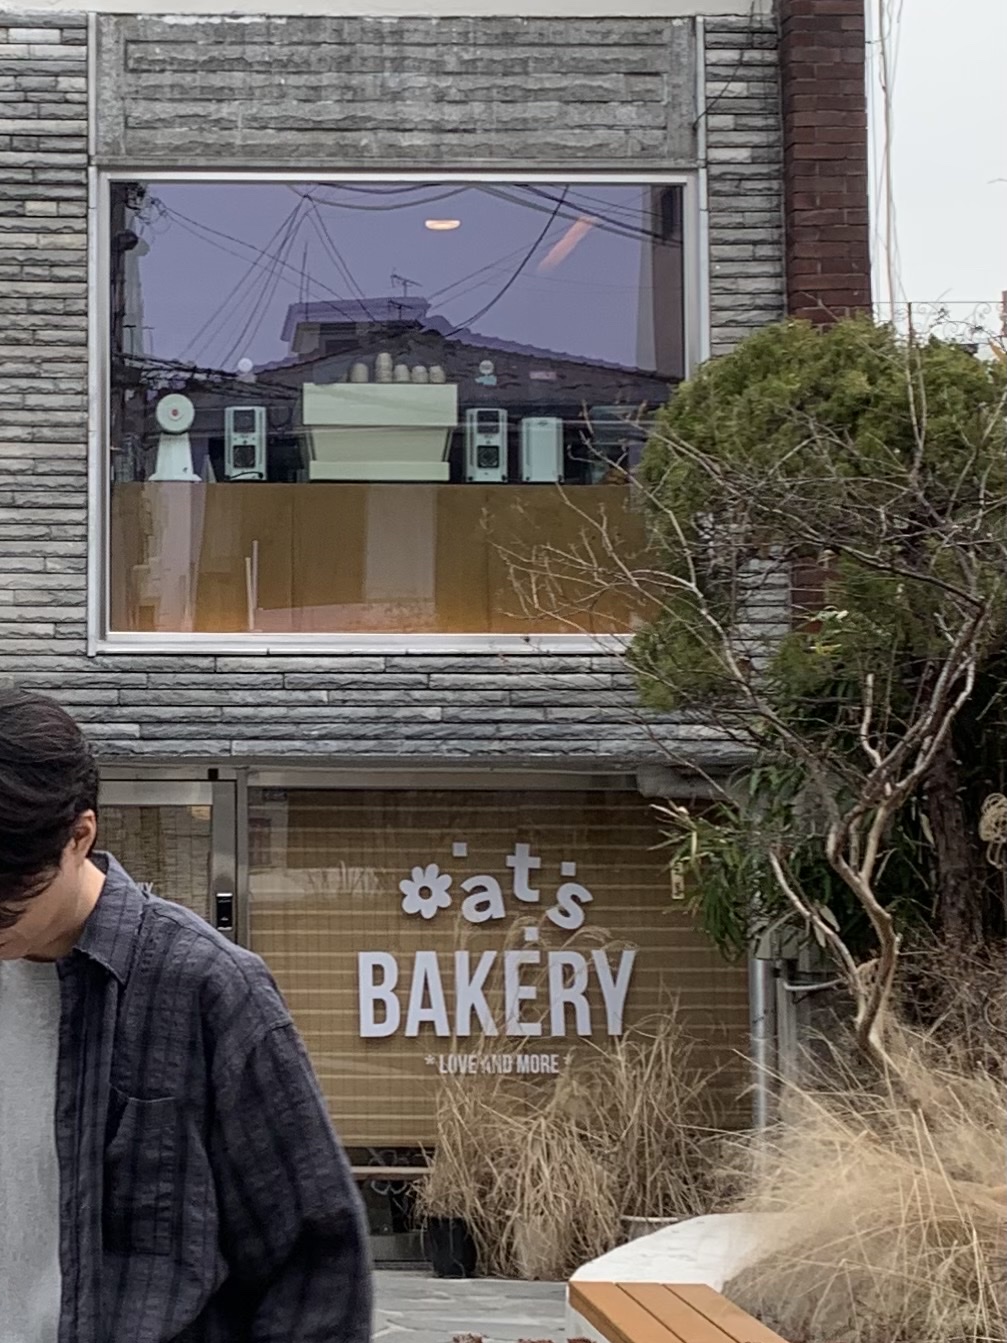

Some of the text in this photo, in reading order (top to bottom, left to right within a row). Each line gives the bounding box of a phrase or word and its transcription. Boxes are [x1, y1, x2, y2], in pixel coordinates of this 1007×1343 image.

[358, 950, 637, 1038] BAKERY
[439, 1054, 478, 1074] LOVE
[516, 1054, 559, 1074] MORE
